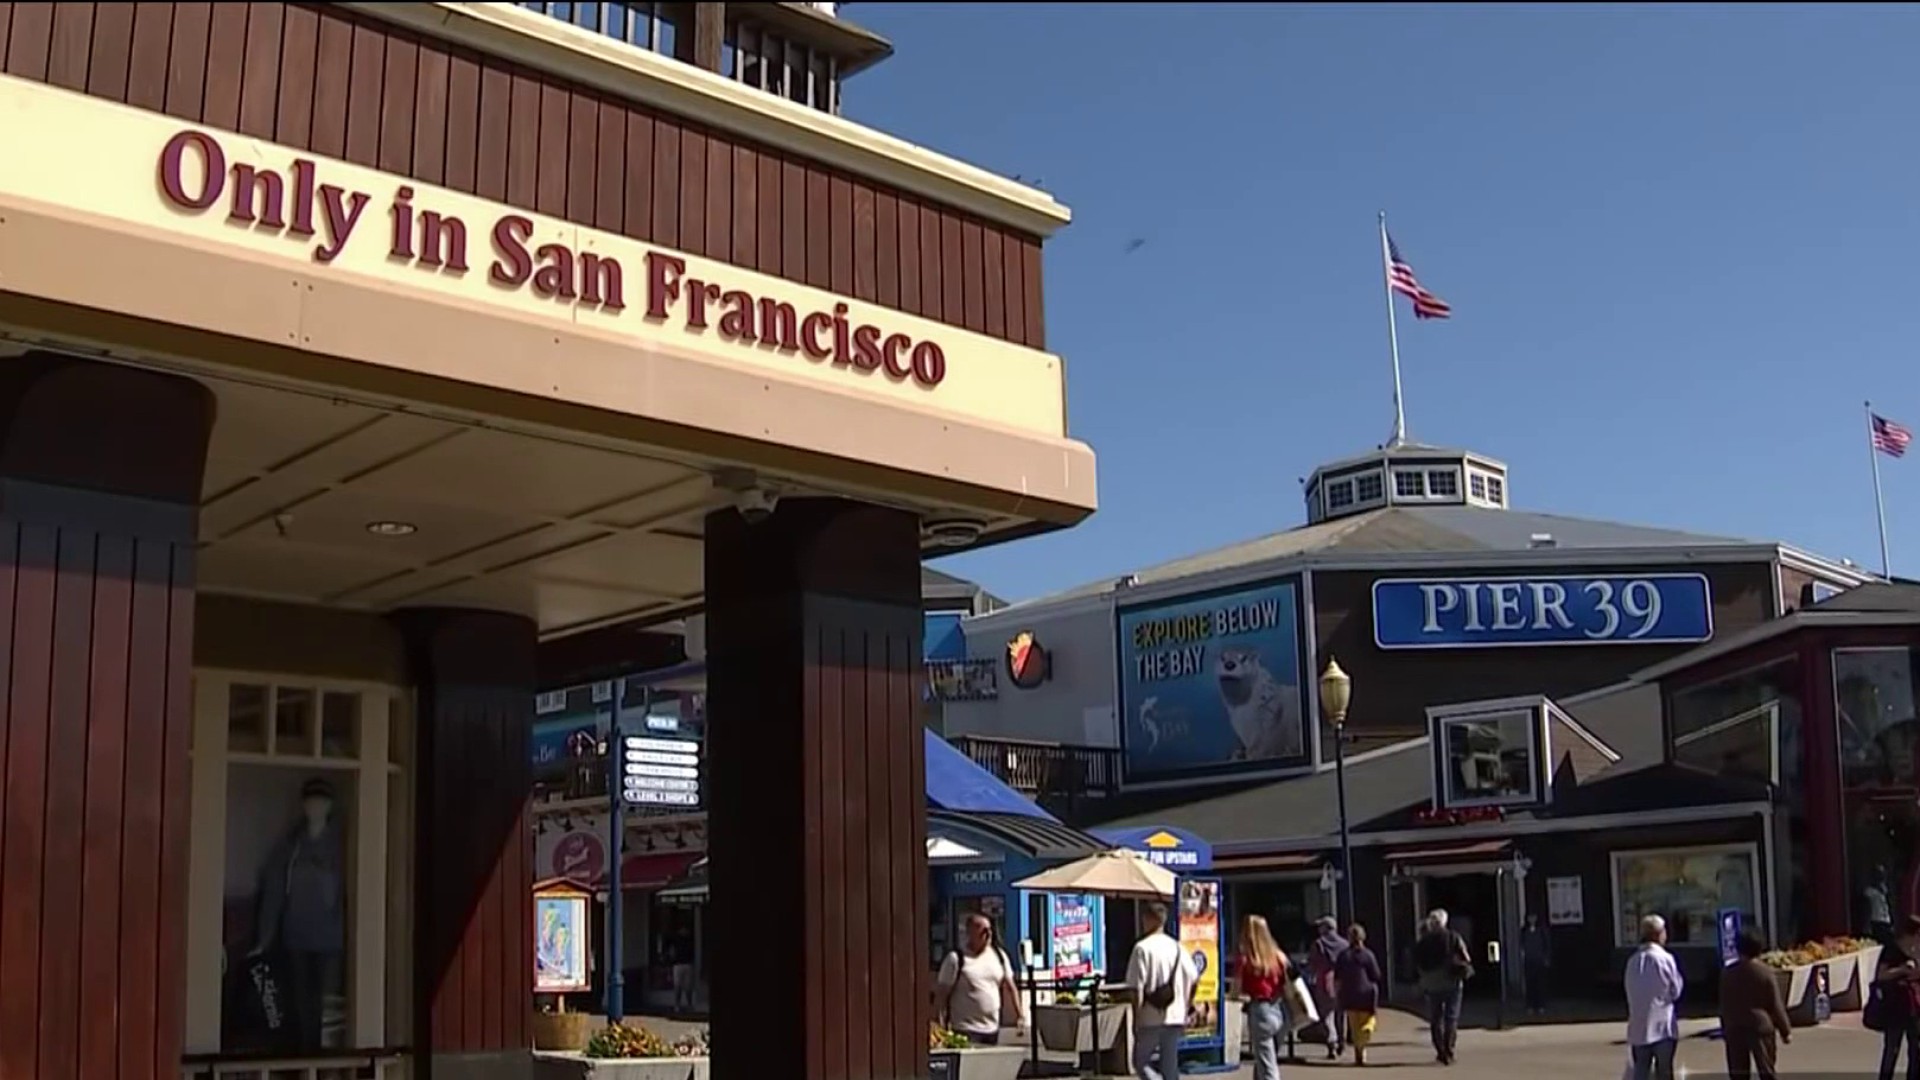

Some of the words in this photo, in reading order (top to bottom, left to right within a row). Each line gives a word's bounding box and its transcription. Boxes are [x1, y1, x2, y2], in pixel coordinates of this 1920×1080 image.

[159, 129, 371, 263] Only
[389, 185, 469, 273] in
[490, 214, 626, 310] San
[643, 250, 947, 389] Francisco
[1132, 612, 1211, 648] EXPLORE
[1215, 598, 1279, 635] BELOW
[1419, 582, 1575, 633] PIER
[1583, 579, 1662, 639] 39
[1136, 654, 1166, 683] THE
[1169, 646, 1206, 676] BAY
[952, 869, 1002, 884] TICKETS
